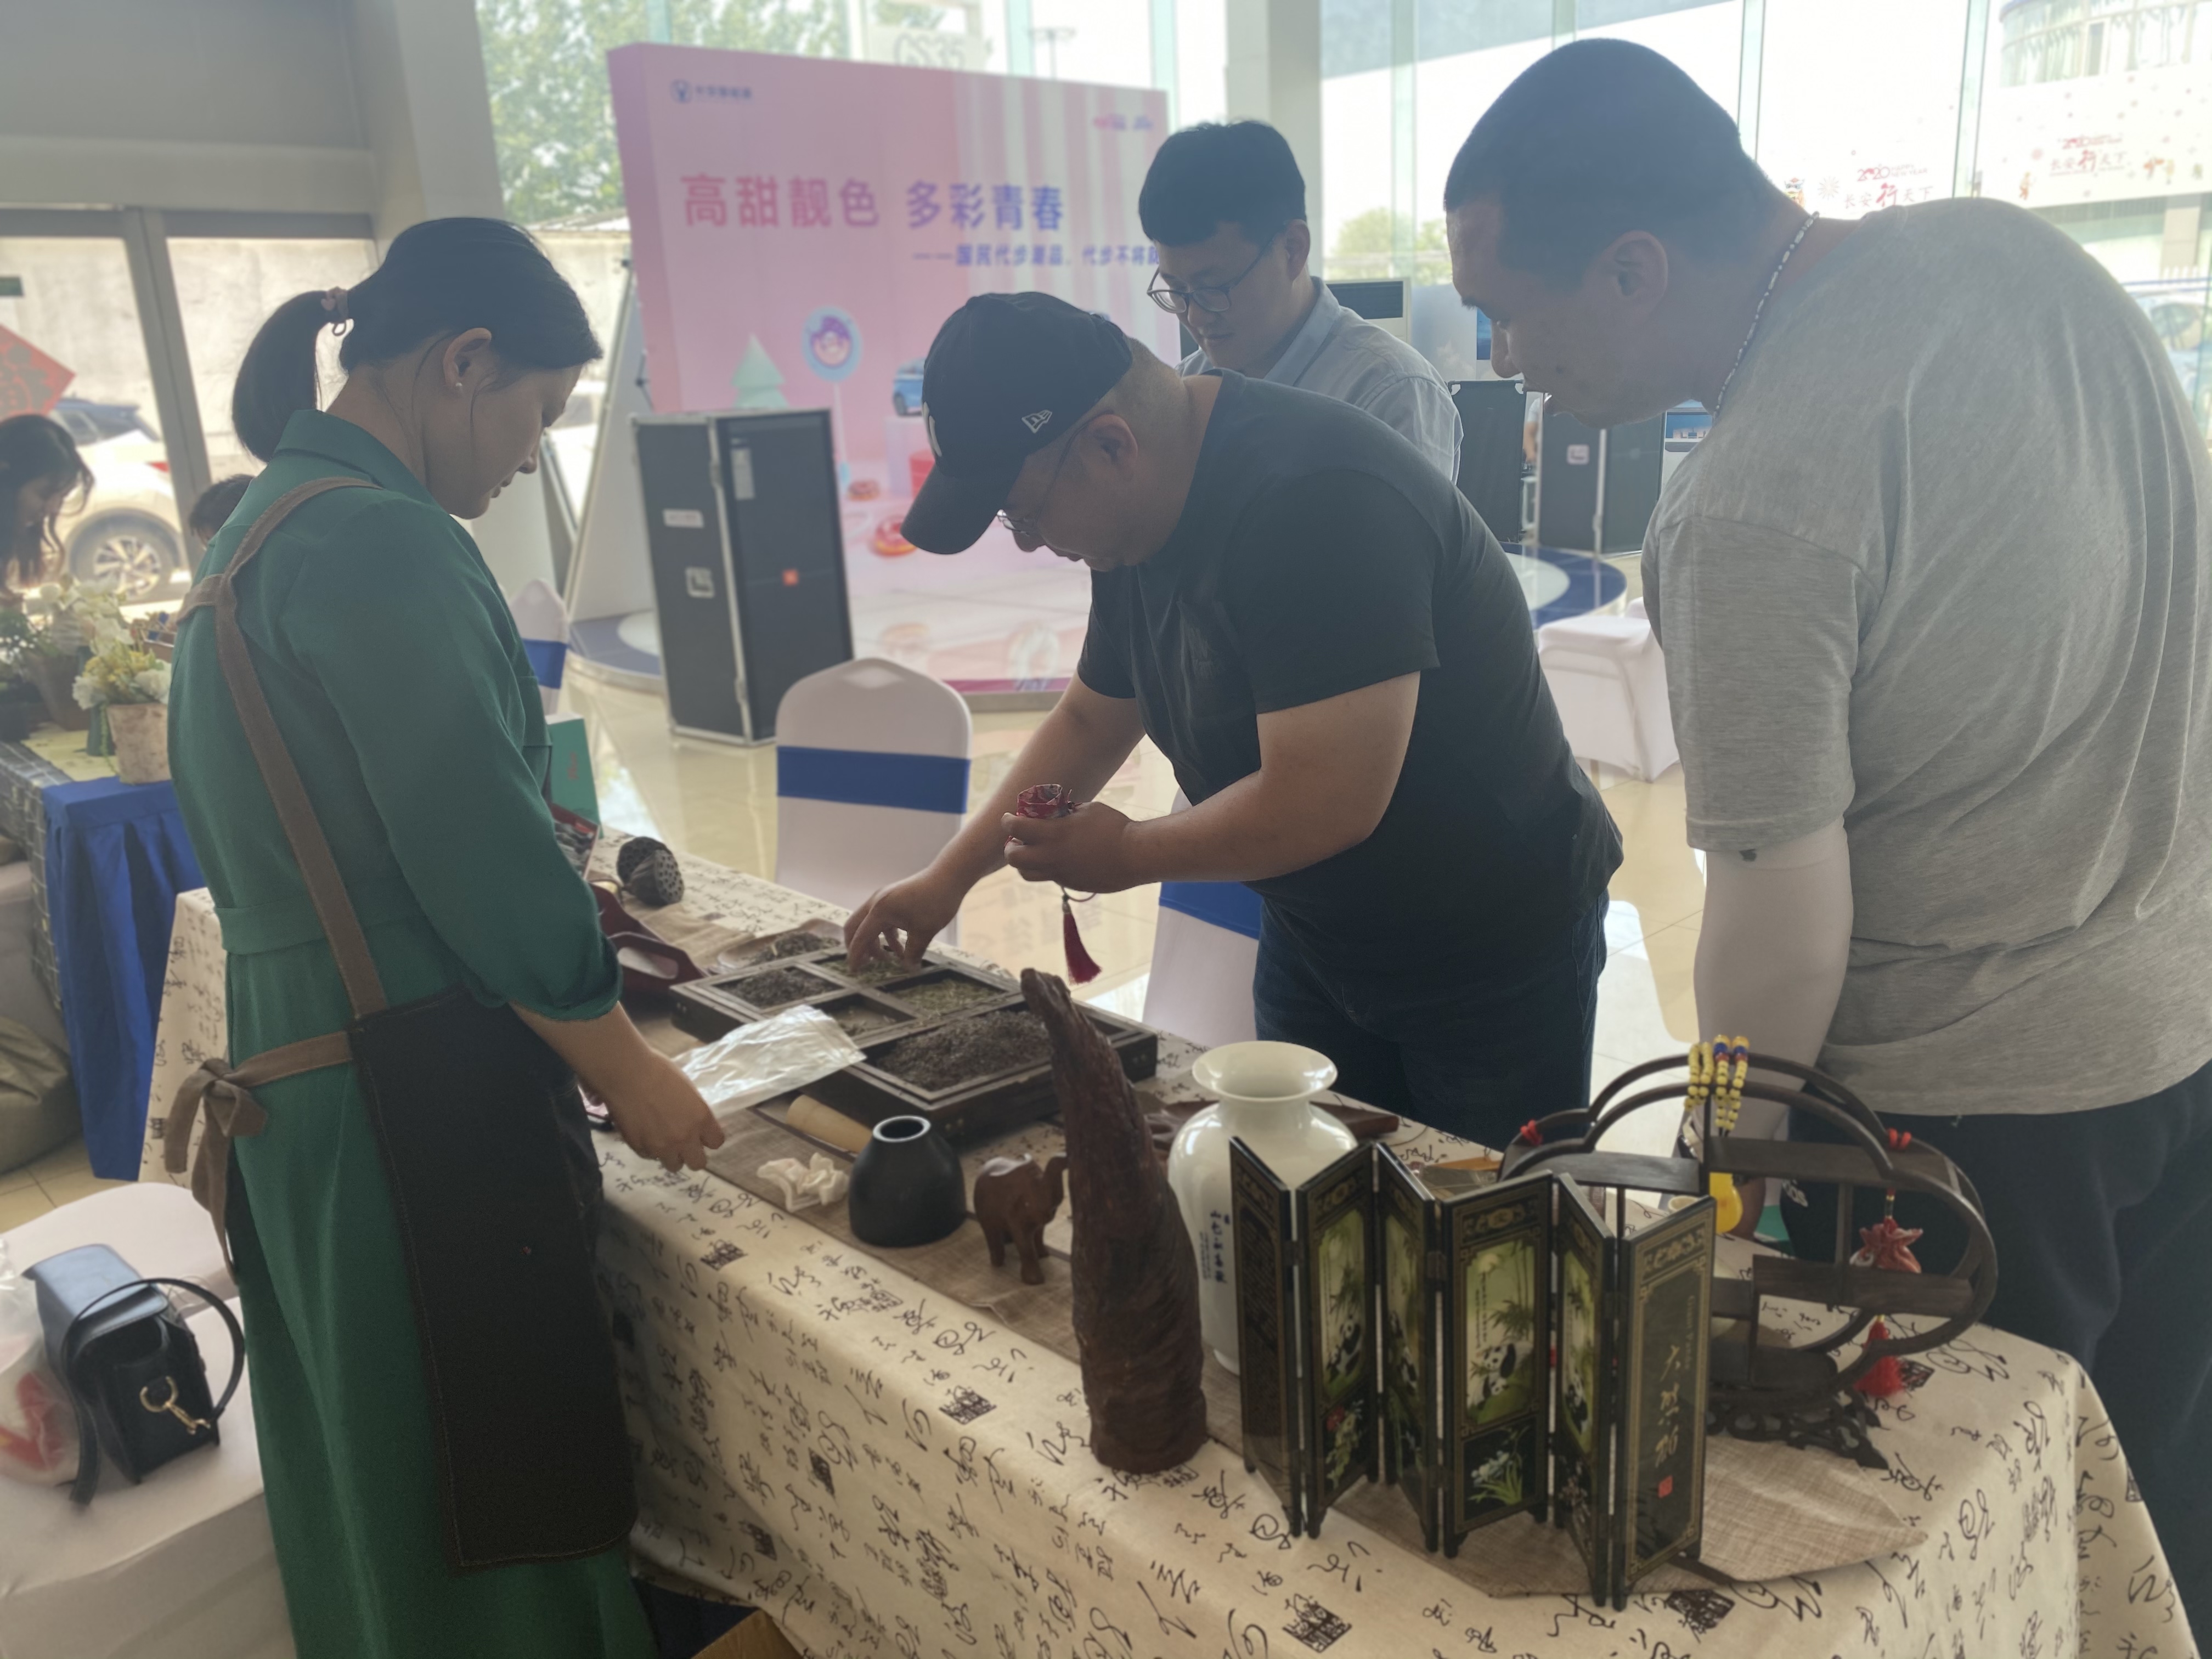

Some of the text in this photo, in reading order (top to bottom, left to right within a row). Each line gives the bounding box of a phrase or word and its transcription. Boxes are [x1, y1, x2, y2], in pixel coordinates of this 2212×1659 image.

[681, 173, 1063, 231] 高甜靓色 多彩青春
[1844, 182, 1933, 209] 长安行天下
